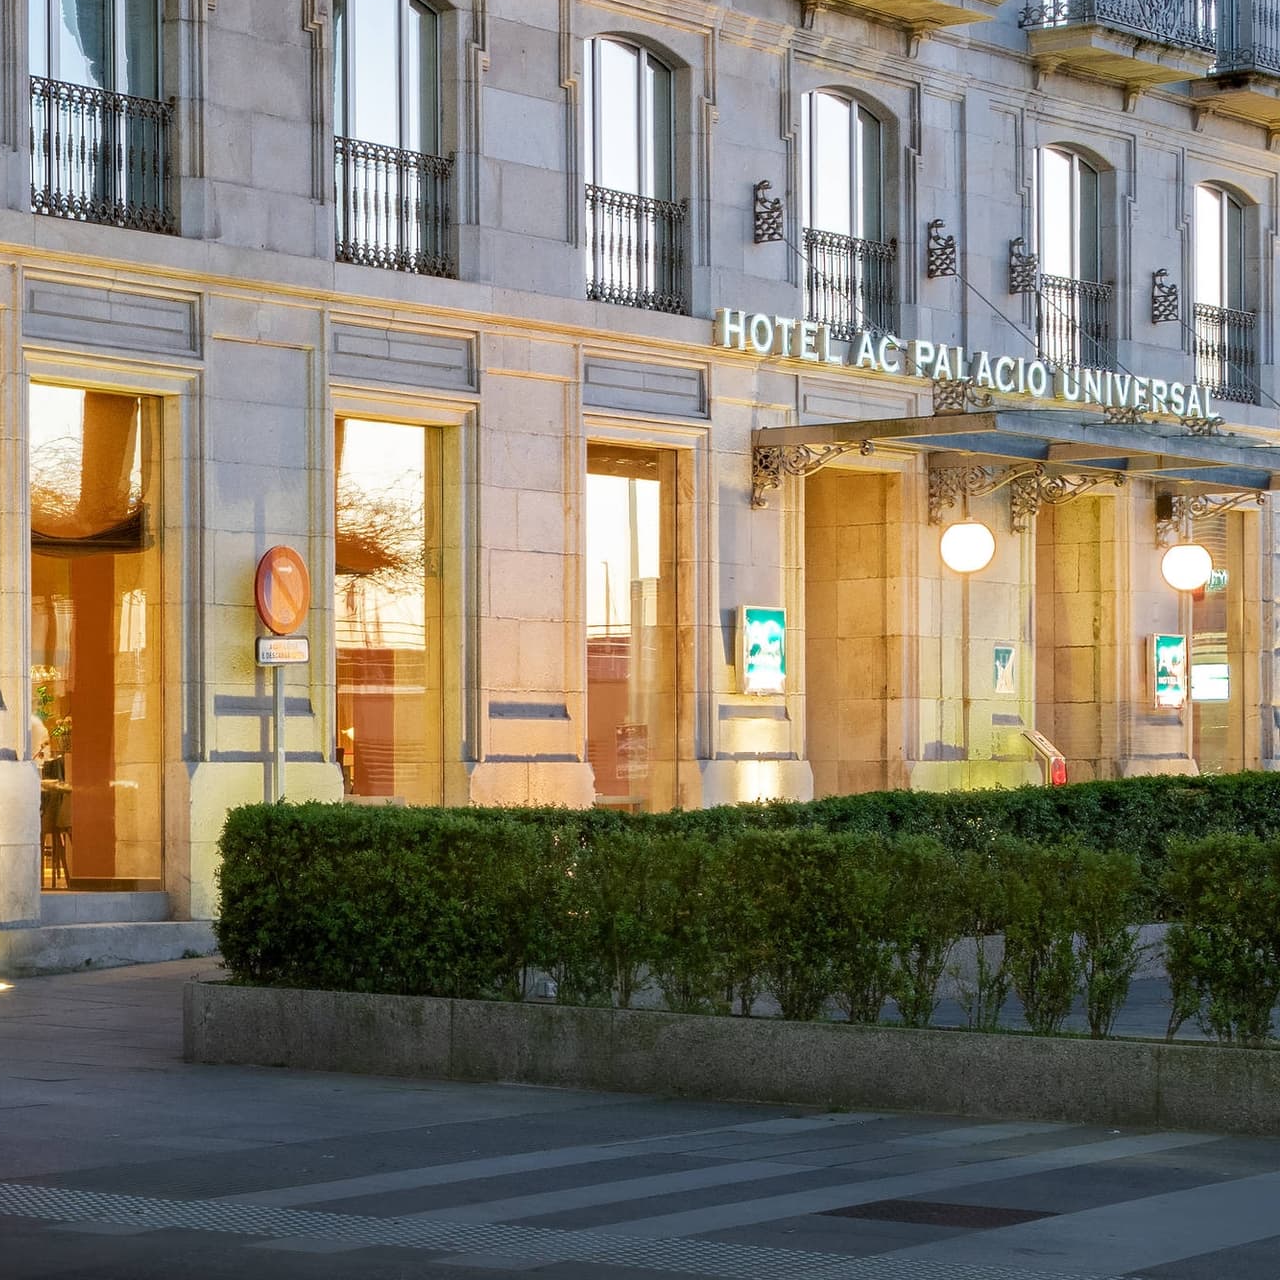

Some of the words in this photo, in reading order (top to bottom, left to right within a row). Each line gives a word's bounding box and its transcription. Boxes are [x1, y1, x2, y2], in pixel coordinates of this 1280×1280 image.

[719, 307, 842, 365] HOTEL
[855, 330, 900, 373] AC
[914, 340, 1048, 398] PALACIO
[1062, 365, 1220, 419] UNIVERSAL
